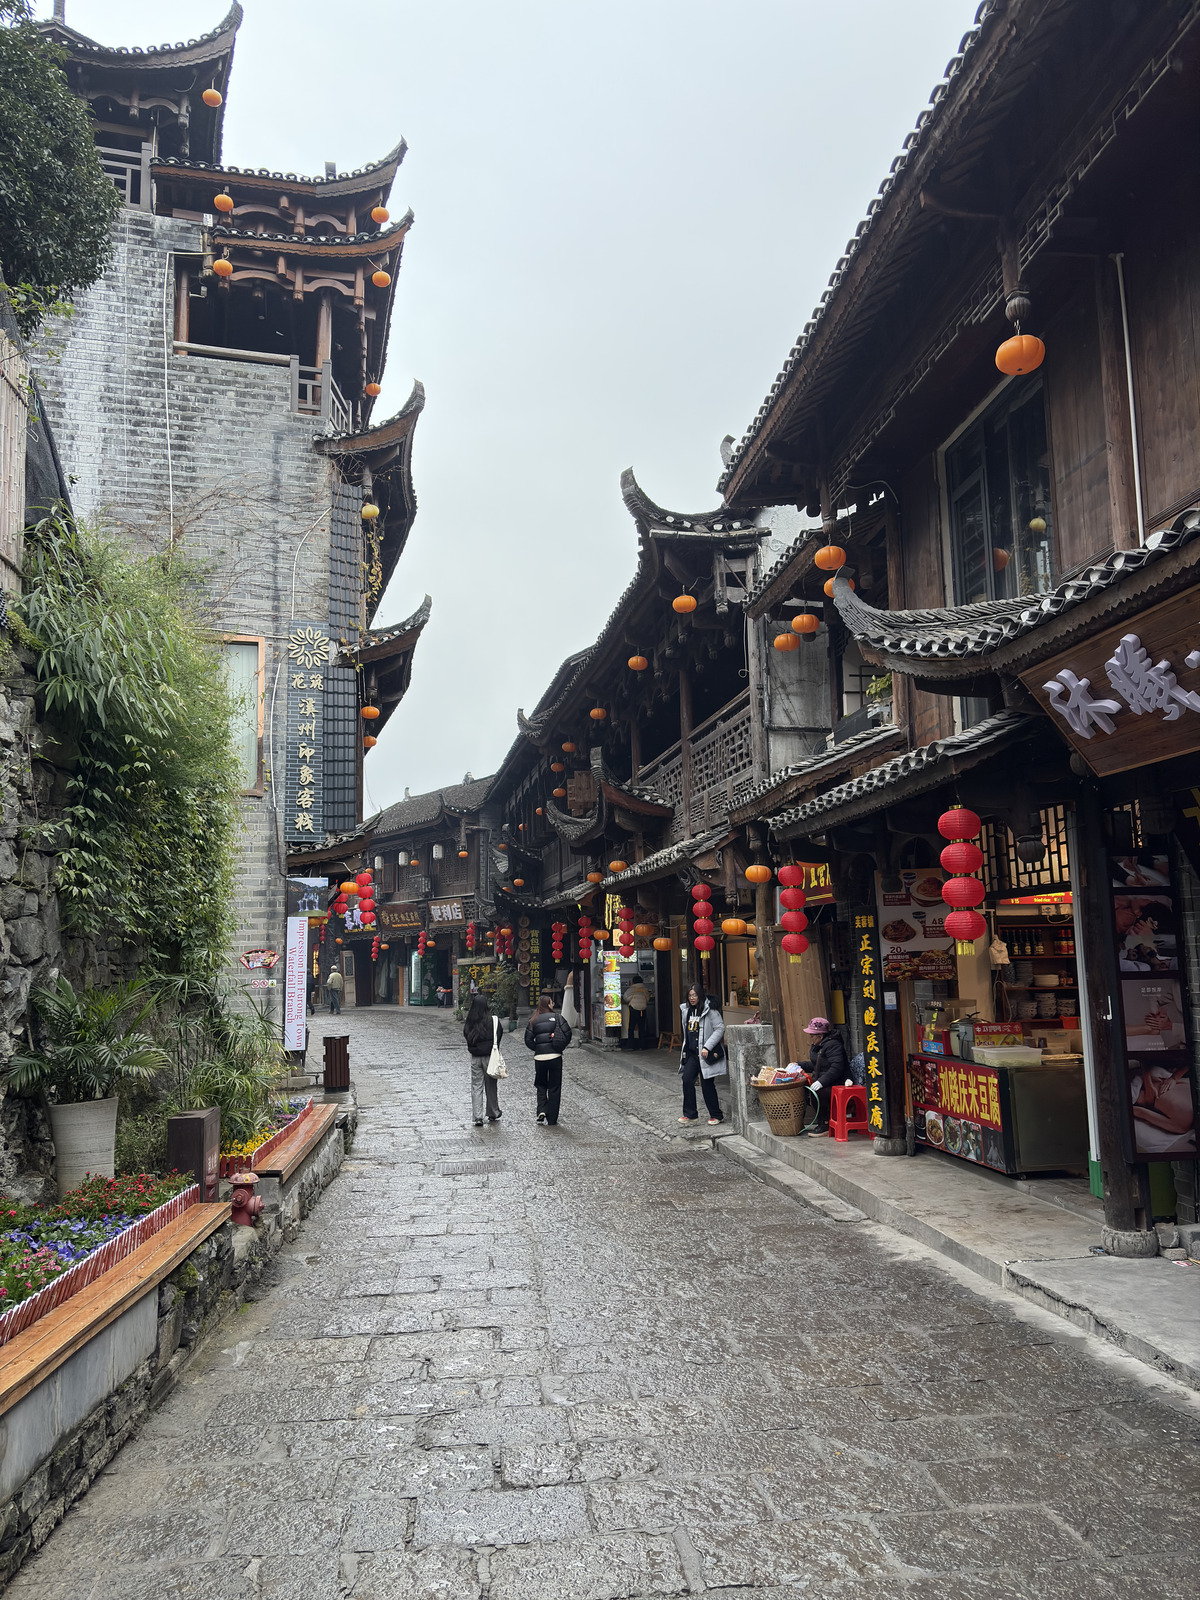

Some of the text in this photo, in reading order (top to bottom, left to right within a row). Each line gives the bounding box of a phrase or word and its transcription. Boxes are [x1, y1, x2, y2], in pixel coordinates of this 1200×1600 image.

[291, 672, 324, 691] 花筑
[293, 698, 319, 834] 溪州印象客栈
[431, 902, 462, 922] 便利店
[286, 947, 297, 1024] Waterfall Branch
[294, 919, 307, 1048] Impression Inn Furong Town
[859, 934, 884, 1131] 正宗刘晓庆米豆腐
[939, 1065, 1002, 1126] 刘晓庆米豆腐
